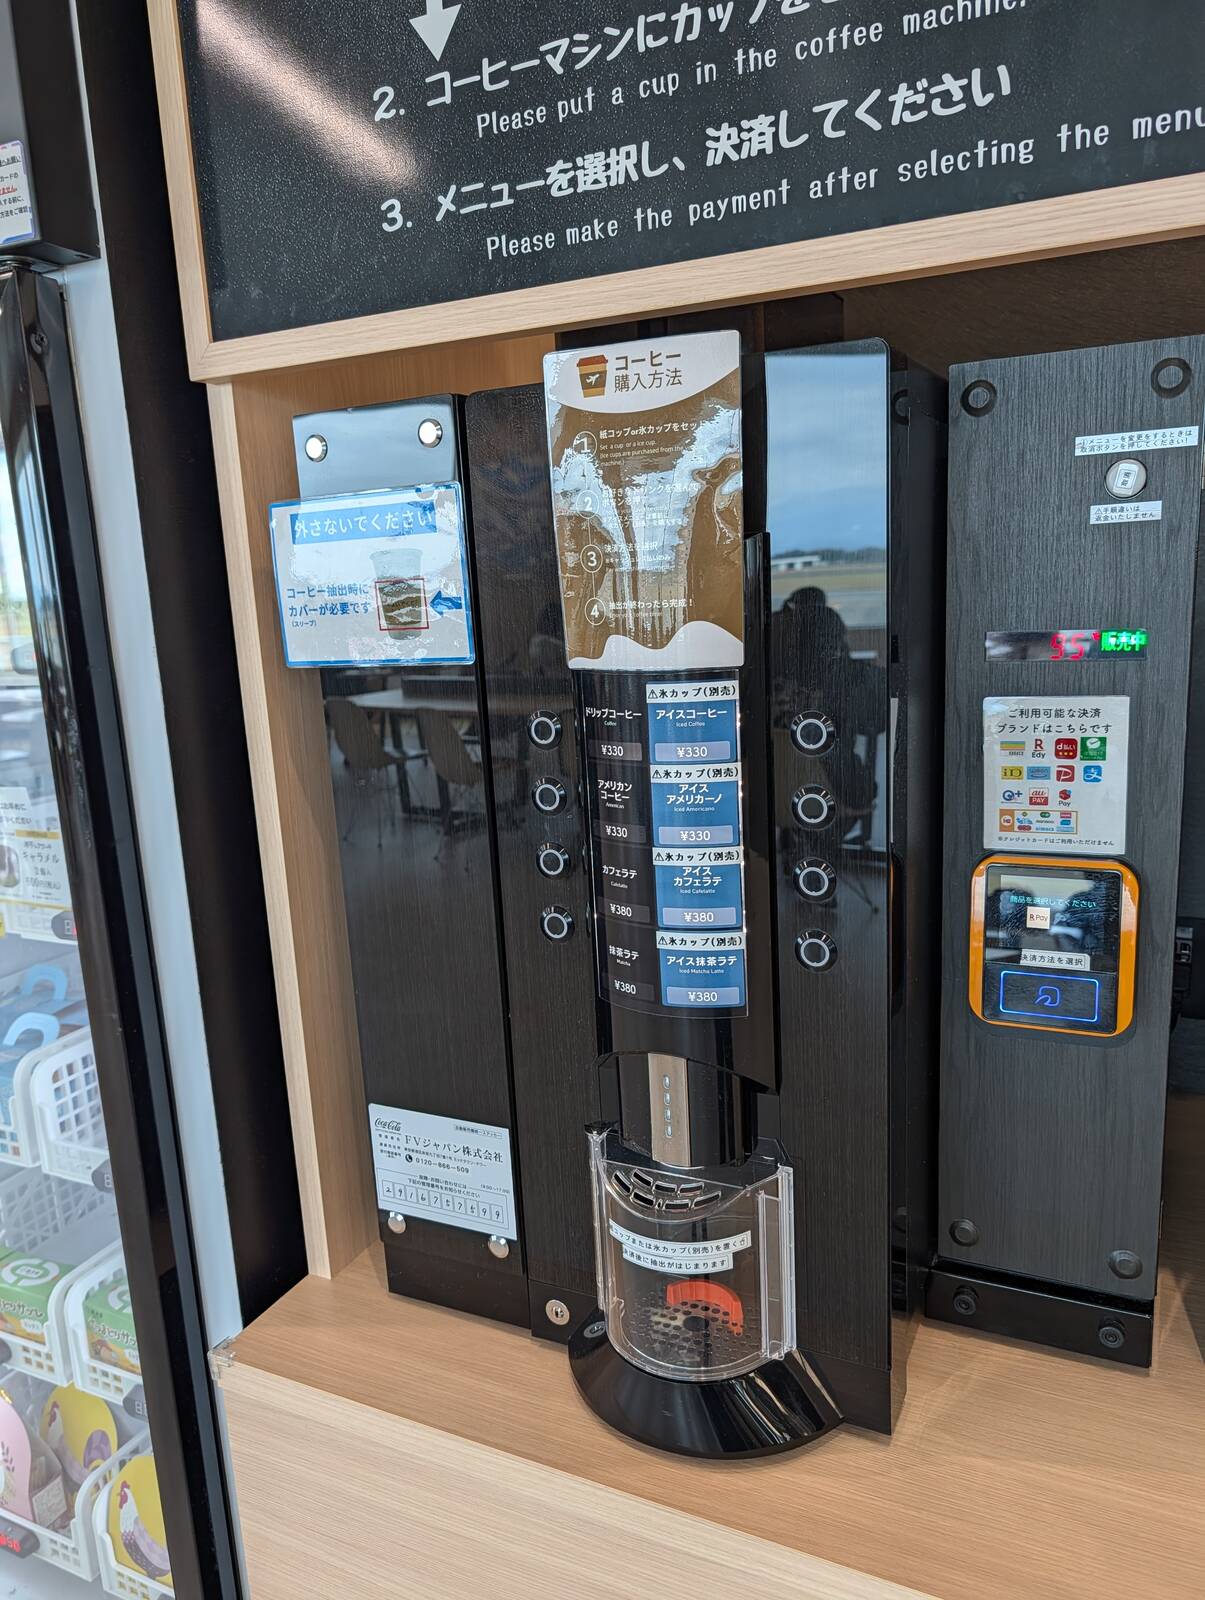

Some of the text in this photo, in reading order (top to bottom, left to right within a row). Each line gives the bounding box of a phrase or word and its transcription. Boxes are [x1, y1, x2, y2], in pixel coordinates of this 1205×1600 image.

[477, 104, 547, 138] Please
[558, 86, 595, 122] put
[611, 86, 624, 105] a
[638, 73, 679, 98] cup
[696, 61, 717, 85] in
[734, 48, 777, 75] the
[795, 23, 884, 61] coffee
[373, 86, 405, 121] 2.
[486, 230, 556, 260] Please
[566, 218, 619, 246] make
[634, 207, 673, 232] the
[689, 178, 791, 227] payment
[809, 166, 879, 199] after
[898, 137, 1035, 182] selecting
[1056, 123, 1110, 153] the
[381, 198, 413, 232] 3.
[615, 351, 681, 372] コーヒー
[614, 367, 683, 393] 購入方法
[584, 497, 593, 511] 2
[293, 510, 433, 539] 外さないでください
[586, 552, 597, 567] 3
[287, 583, 369, 600] コーヒー抽出時に
[288, 601, 370, 617] カバーが必要です
[590, 604, 600, 618] 4
[1101, 631, 1148, 651] 販売中
[585, 706, 643, 720] ドリップコーヒー
[656, 708, 728, 720] アイスコーヒー
[1008, 707, 1102, 719] ご利用可能な決済
[997, 722, 1113, 734] ブランドはこちらです
[601, 744, 624, 757] ¥330
[676, 746, 708, 758] ¥330
[1031, 751, 1046, 760] Edy
[597, 779, 633, 791] アメリカン
[679, 783, 709, 794] アイス
[600, 791, 630, 802] コーヒー
[666, 793, 723, 805] アメリカーノ
[605, 825, 628, 838] ¥330
[680, 830, 711, 841] ¥330
[602, 864, 638, 880] カフェラテ
[682, 866, 712, 876] アイス
[673, 876, 723, 887] カフェラテ
[609, 903, 632, 917] ¥380
[683, 911, 714, 923] ¥380
[608, 945, 640, 961] 抹茶ラテ
[666, 955, 737, 967] アイス抹茶ラテ
[614, 979, 636, 995] ¥380
[687, 991, 718, 1002] ¥380
